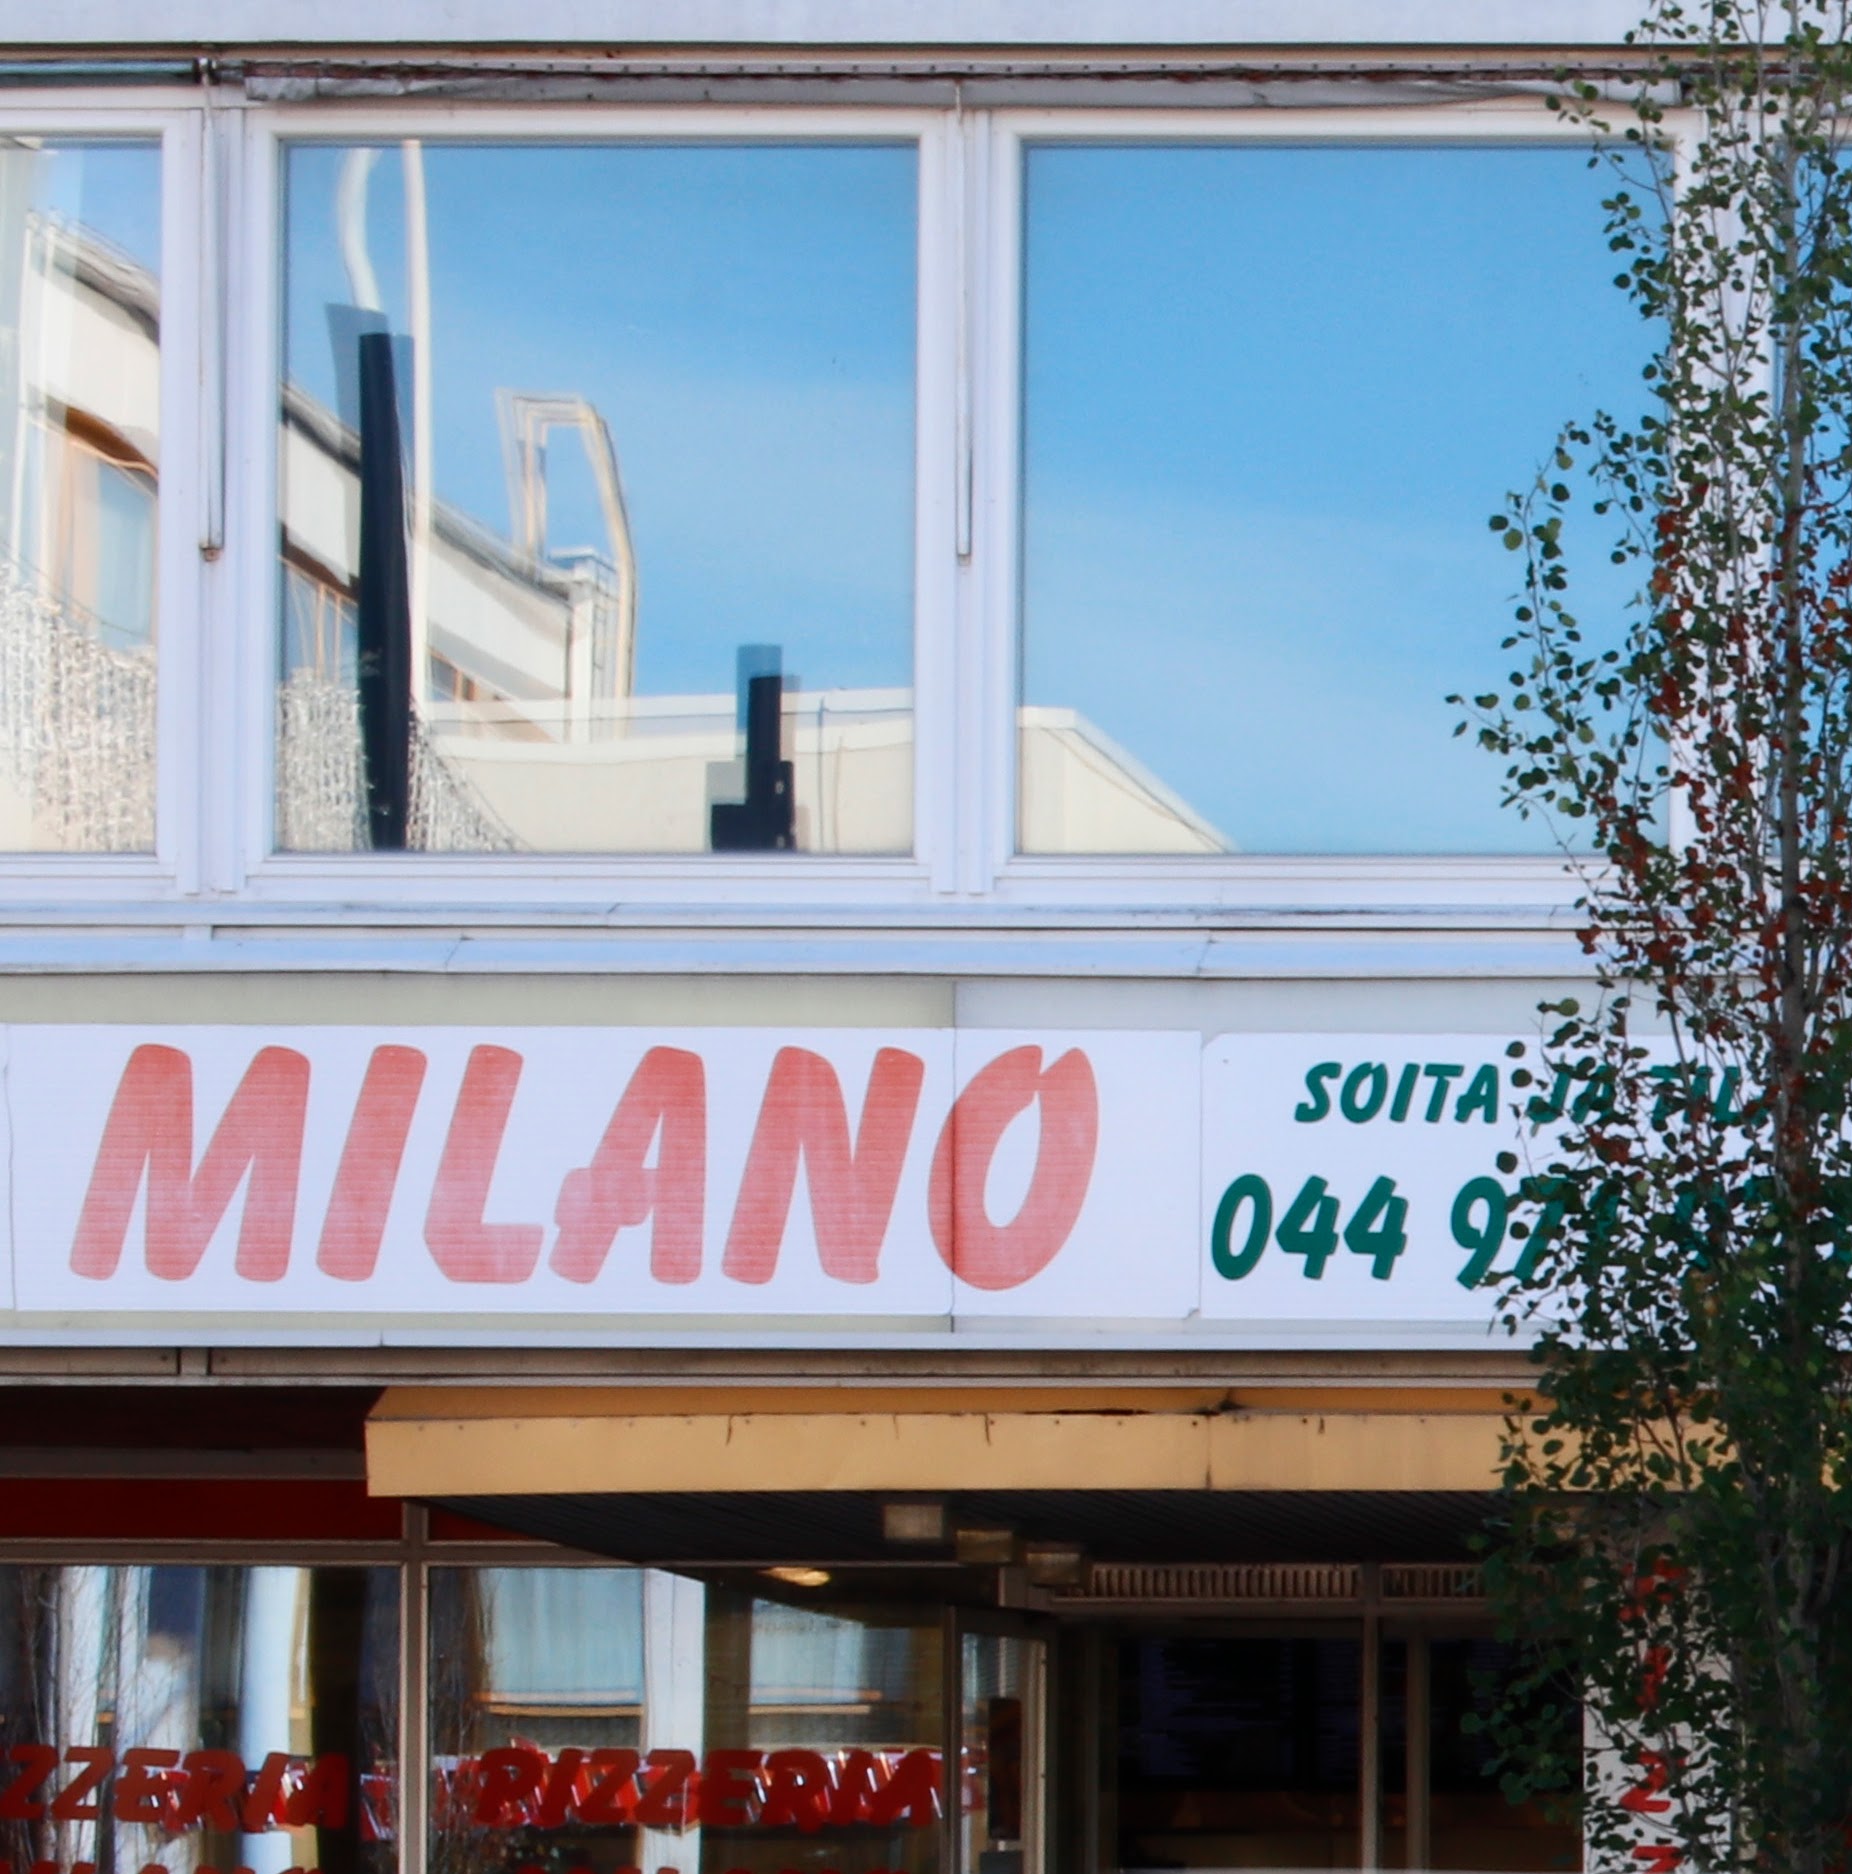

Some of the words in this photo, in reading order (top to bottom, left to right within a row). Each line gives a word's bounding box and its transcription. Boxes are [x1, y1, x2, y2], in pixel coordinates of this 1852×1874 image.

[1294, 1060, 1500, 1124] SOITA
[68, 1042, 1097, 1291] MILANO
[1211, 1173, 1408, 1283] 044
[0, 1744, 350, 1832] ZZERIA
[470, 1747, 941, 1831] PIZZERIA
